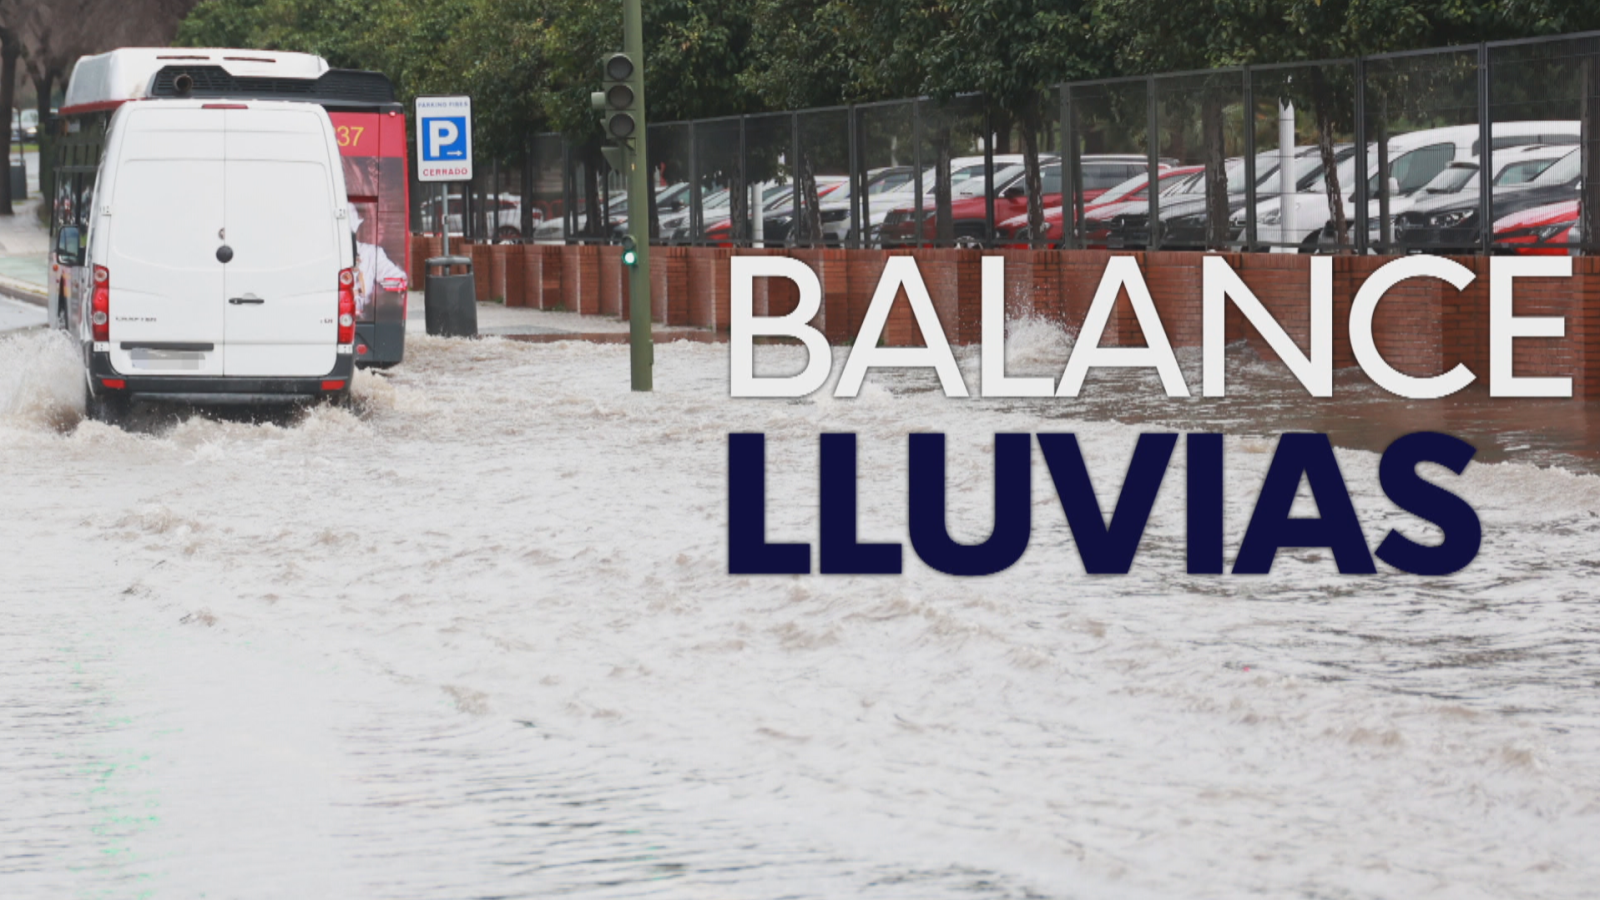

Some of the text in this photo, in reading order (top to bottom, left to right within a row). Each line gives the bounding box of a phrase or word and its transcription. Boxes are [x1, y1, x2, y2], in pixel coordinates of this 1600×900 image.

[334, 125, 365, 147] 37
[429, 120, 459, 157] P
[423, 167, 468, 177] CERRADO
